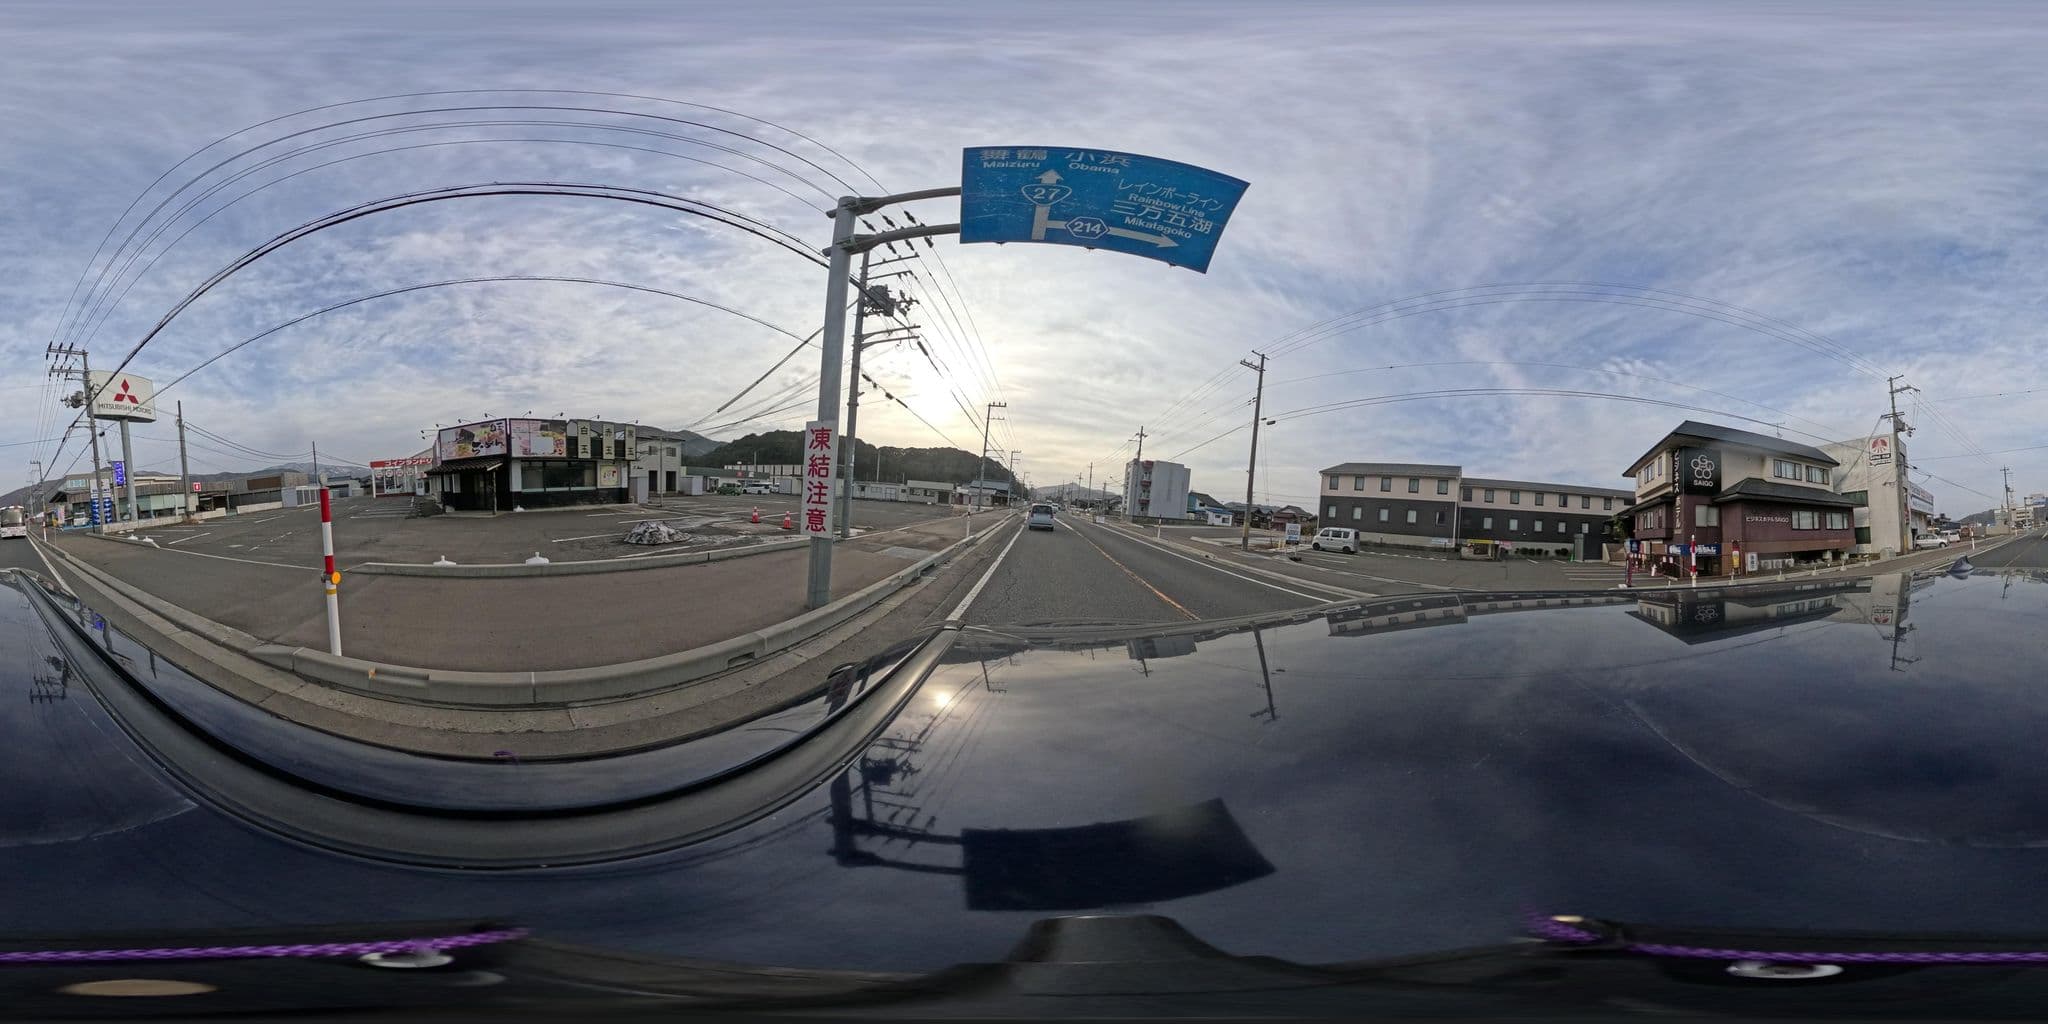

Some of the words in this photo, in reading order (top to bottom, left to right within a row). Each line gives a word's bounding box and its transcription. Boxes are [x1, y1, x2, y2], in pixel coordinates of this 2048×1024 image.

[1068, 162, 1120, 174] Obama
[1033, 187, 1061, 200] 27
[1128, 193, 1182, 211] Rainbow
[1181, 205, 1206, 218] Line
[1110, 199, 1214, 234] 三方五湖
[1072, 221, 1102, 234] 214
[1124, 215, 1193, 239] Mikatagoko
[98, 403, 131, 411] MITSUBISHI
[804, 426, 834, 533] 凍結注意
[1692, 479, 1714, 487] SAIGO
